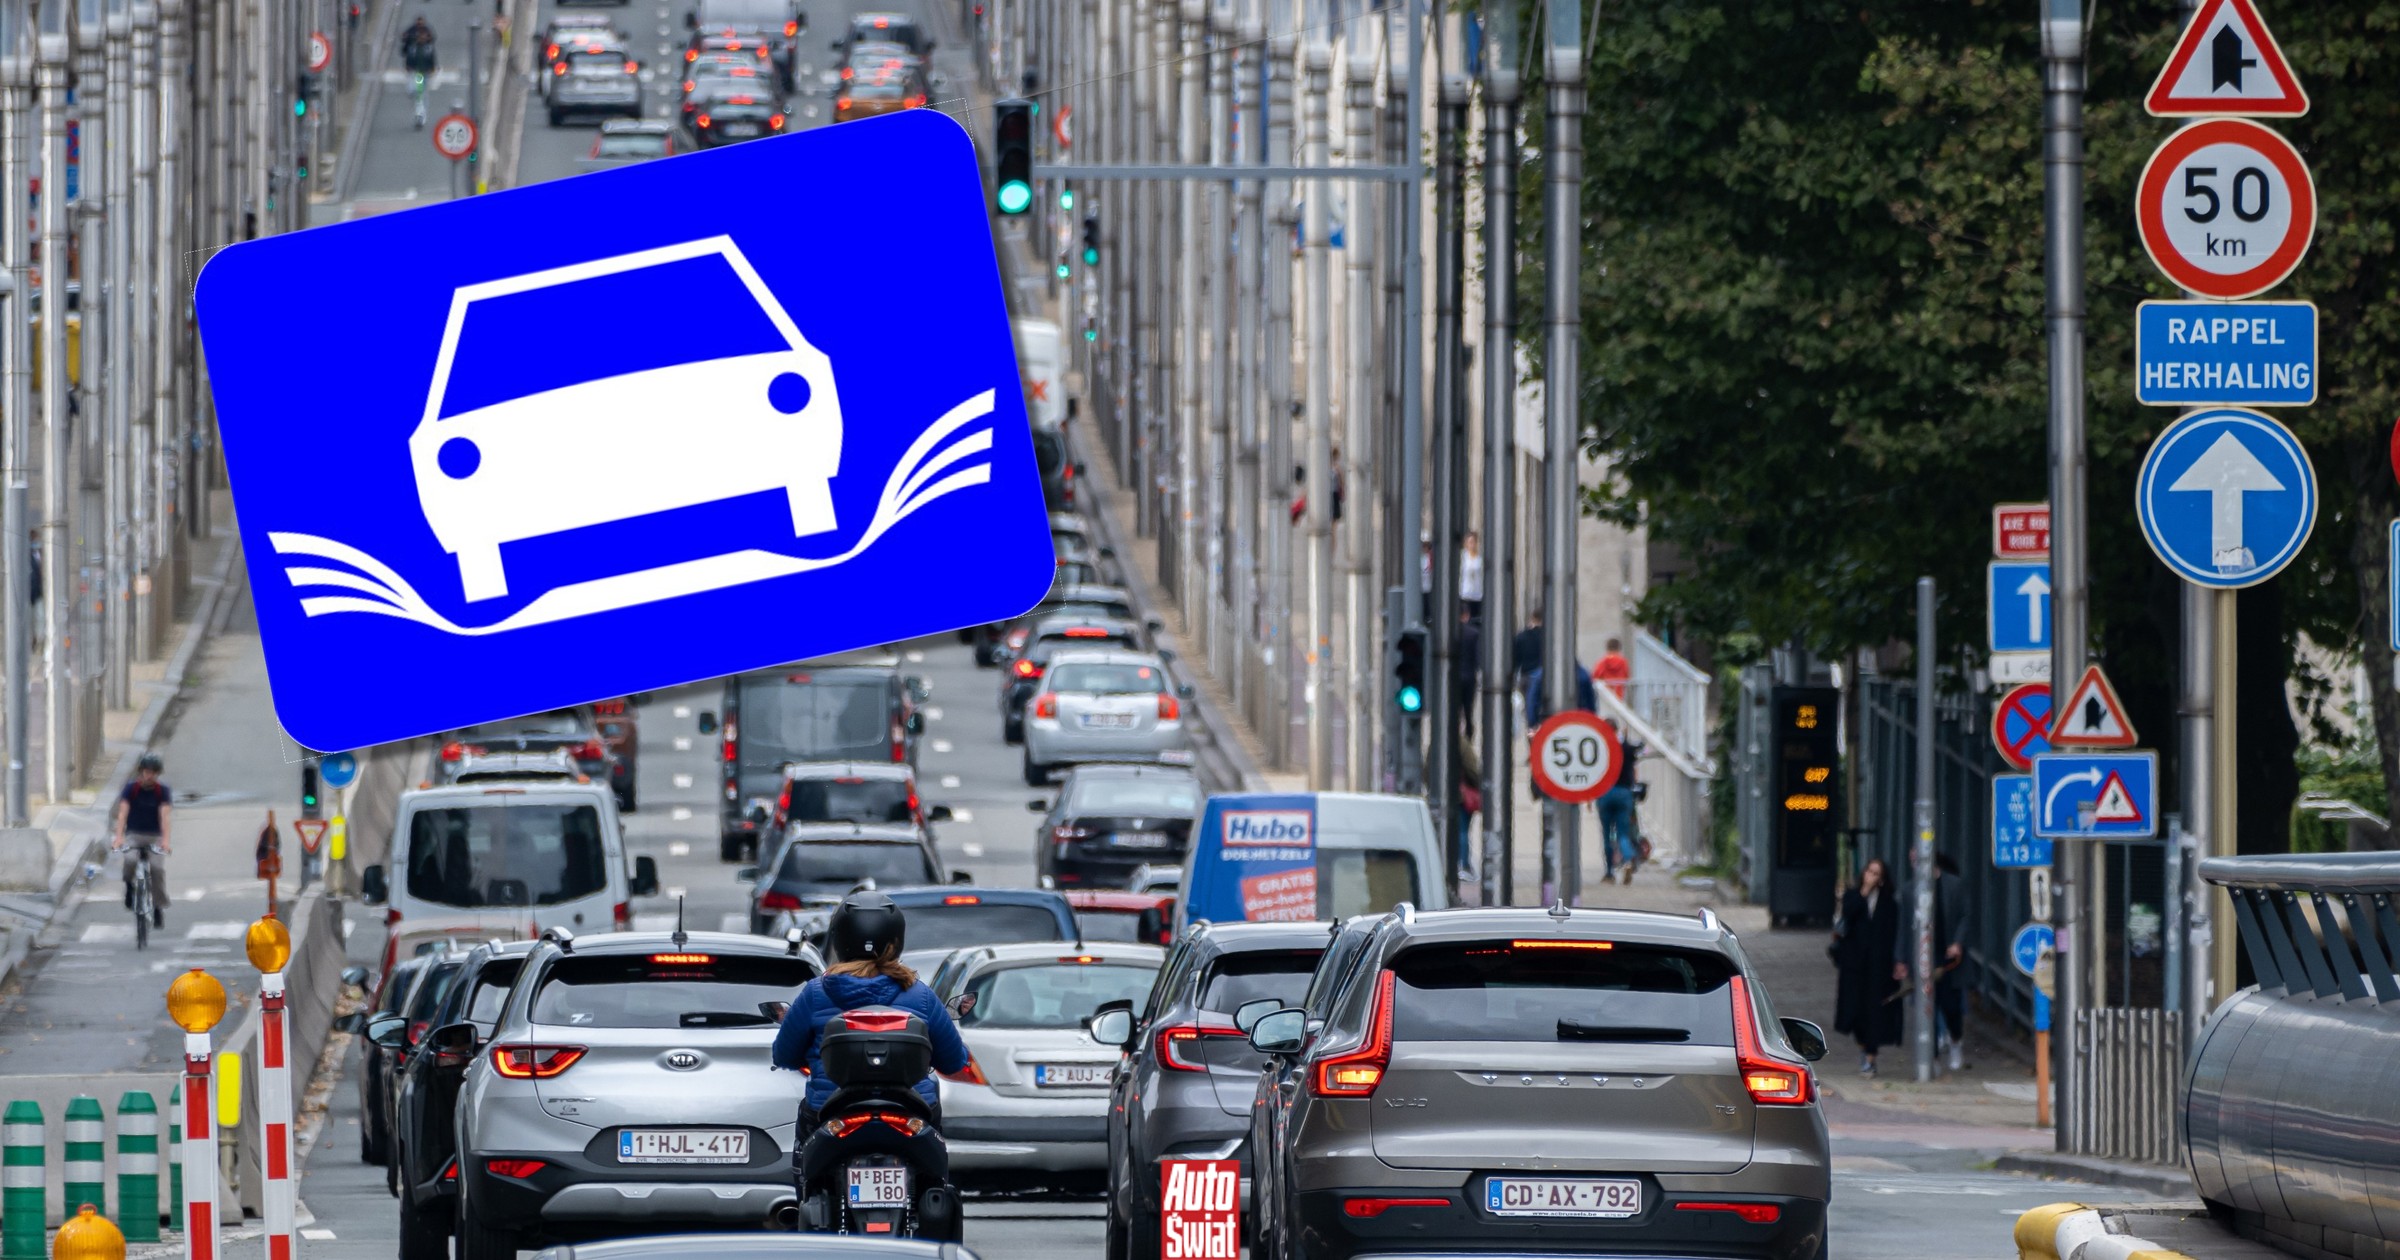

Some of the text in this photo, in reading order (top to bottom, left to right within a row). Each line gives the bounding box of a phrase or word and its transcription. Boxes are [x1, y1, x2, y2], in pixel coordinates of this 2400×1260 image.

[2183, 166, 2271, 224] 50
[2206, 232, 2247, 257] km
[2168, 318, 2286, 345] RAPPEL
[2144, 361, 2311, 390] HERHALING
[1552, 736, 1599, 768] 50
[1229, 817, 1305, 840] Hubo
[1258, 871, 1315, 894] GRATIS
[671, 1054, 695, 1066] KIA
[1482, 1075, 1645, 1087] VOLVO
[875, 1186, 904, 1200] 180
